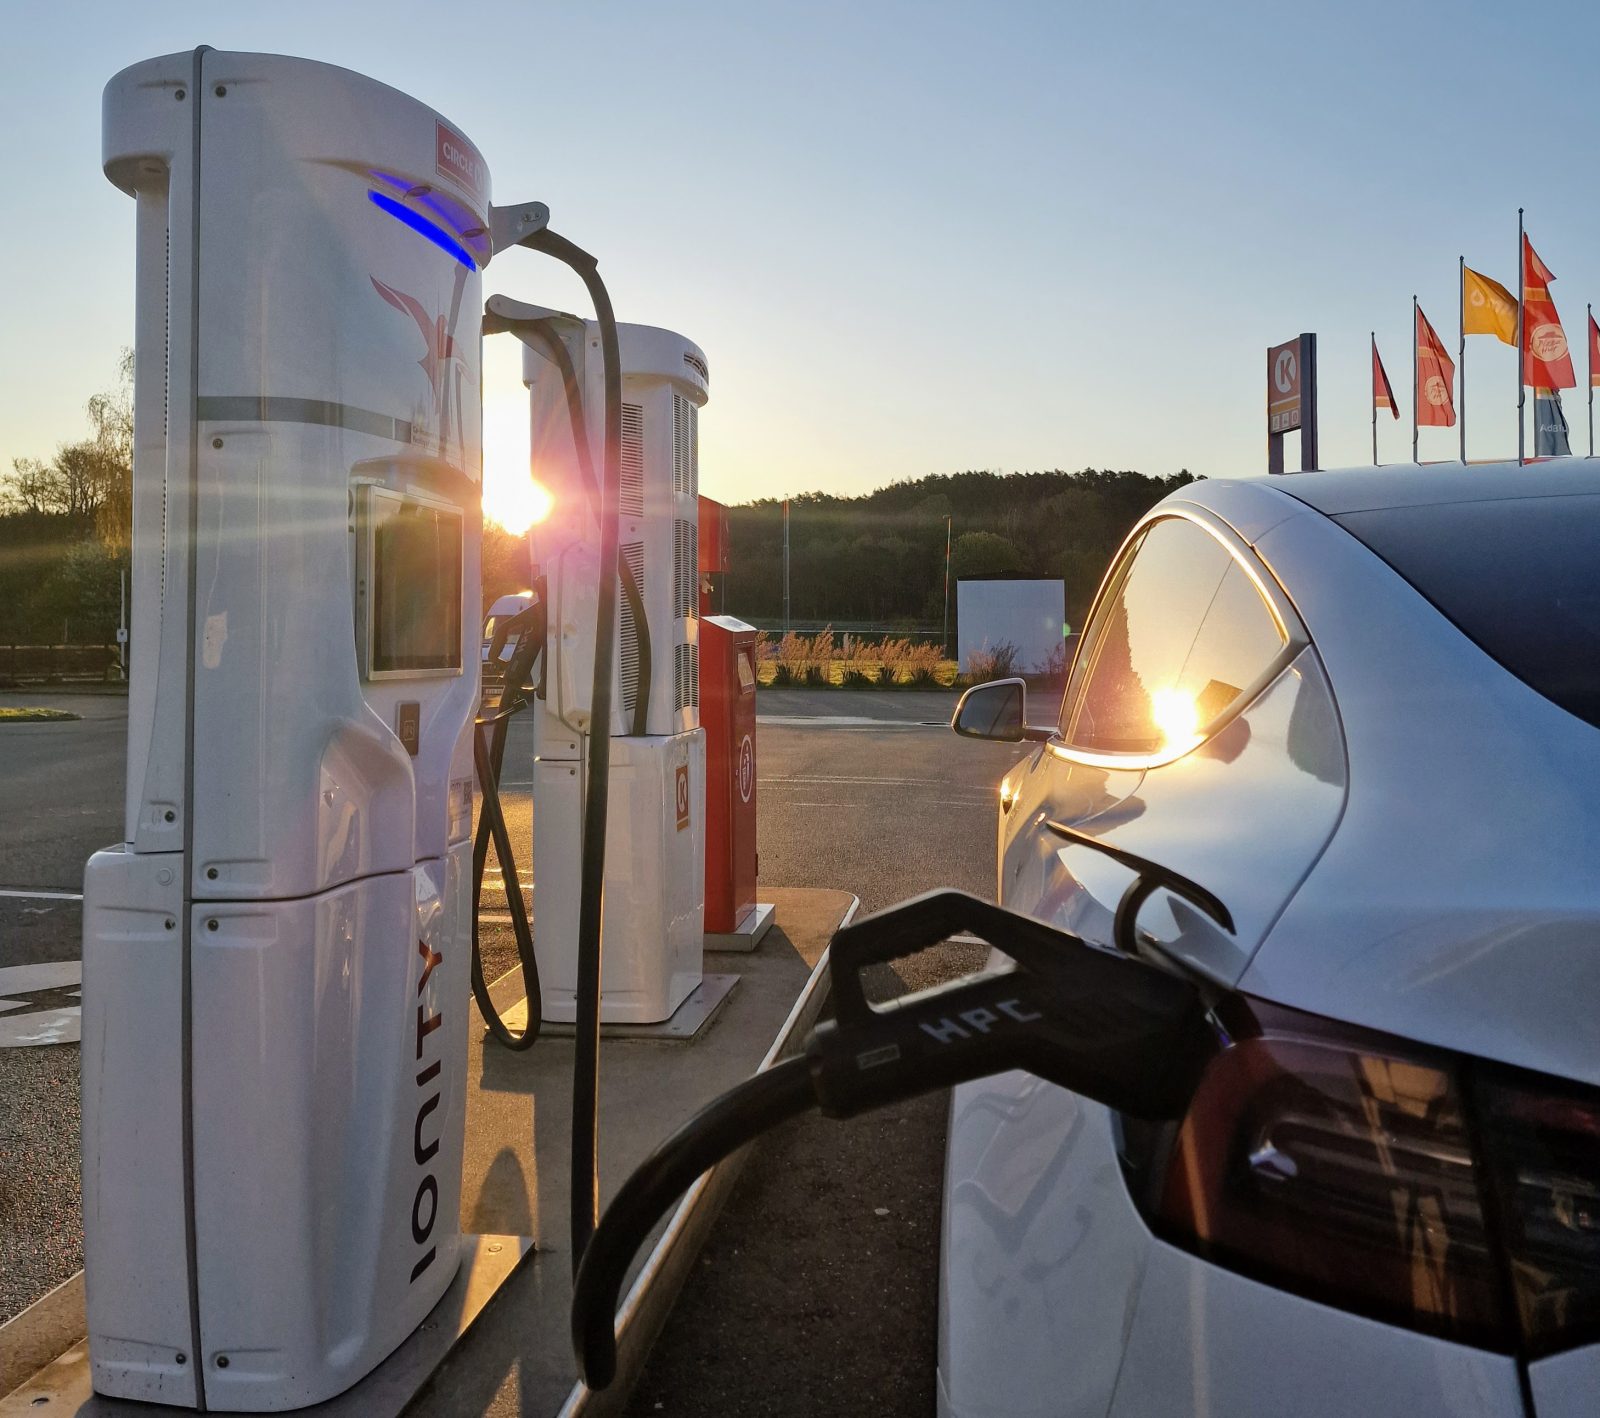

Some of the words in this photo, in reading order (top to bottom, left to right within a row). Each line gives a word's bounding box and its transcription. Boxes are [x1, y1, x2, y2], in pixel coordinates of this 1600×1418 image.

[443, 142, 474, 177] CIRCLE
[1279, 354, 1295, 387] K
[918, 999, 1043, 1044] HPC
[410, 939, 443, 1285] IONITY
